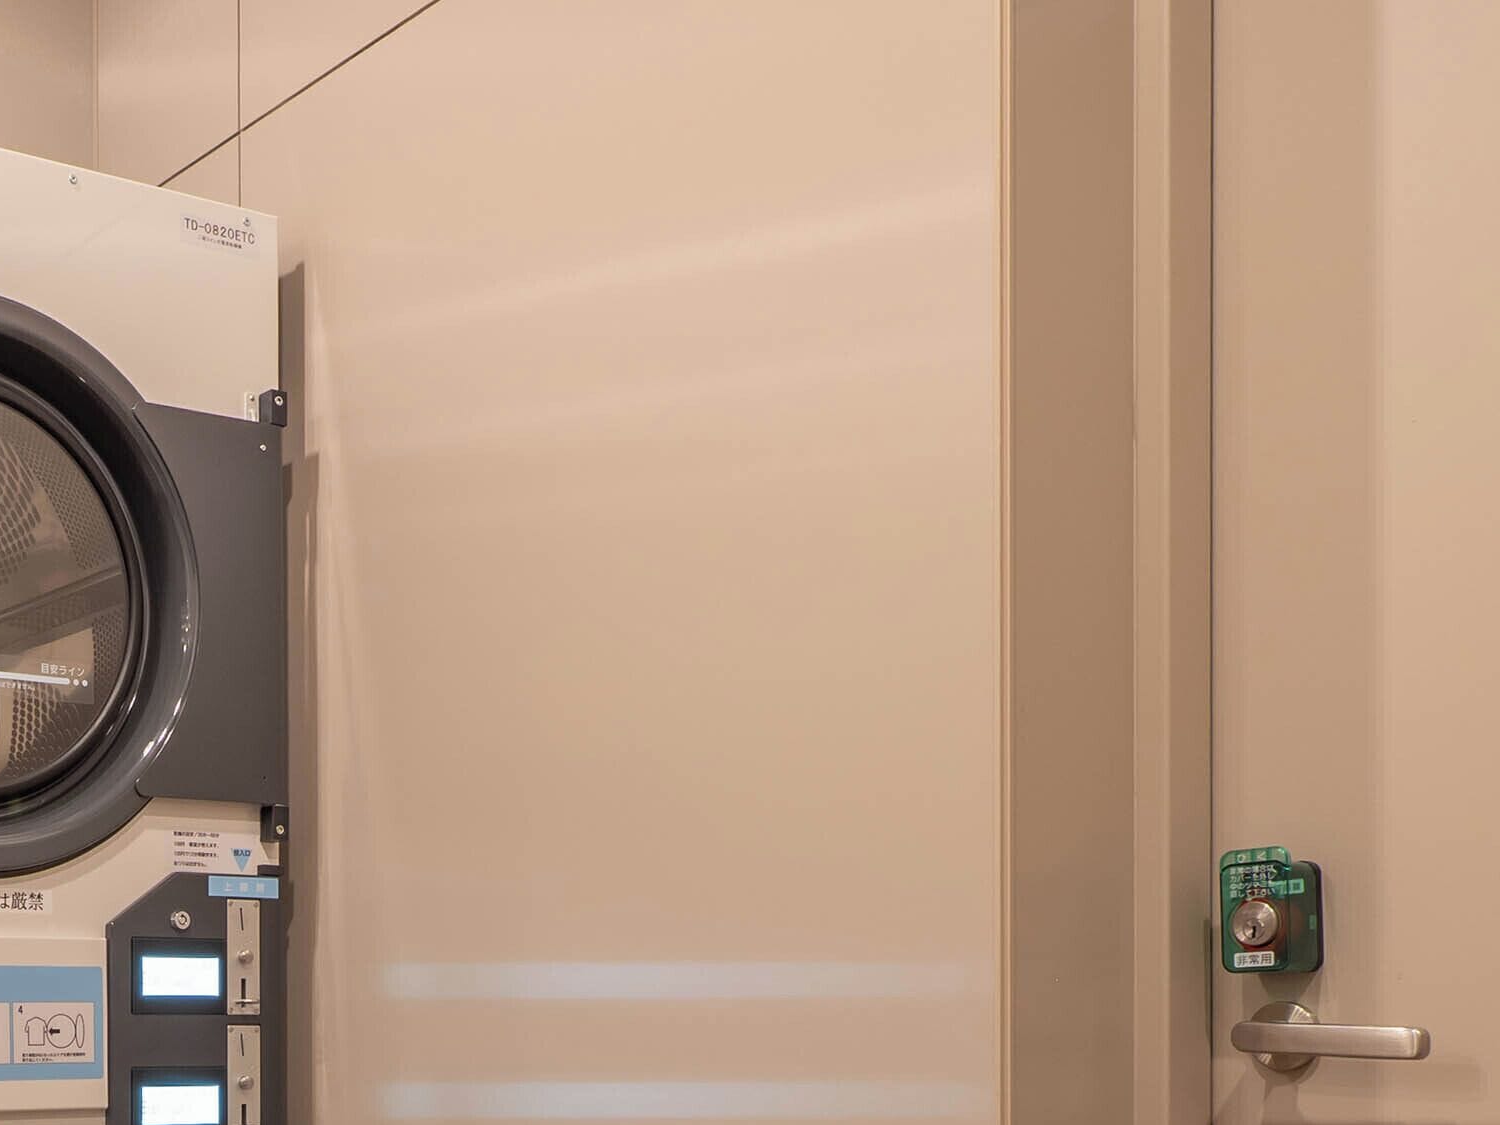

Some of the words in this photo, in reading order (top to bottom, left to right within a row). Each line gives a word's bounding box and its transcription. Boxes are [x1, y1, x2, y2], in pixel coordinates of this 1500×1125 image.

[184, 217, 255, 245] TD-0820ETC
[41, 662, 85, 677] 目安ライン
[1235, 952, 1273, 966] 非常用
[18, 1006, 24, 1015] 4
